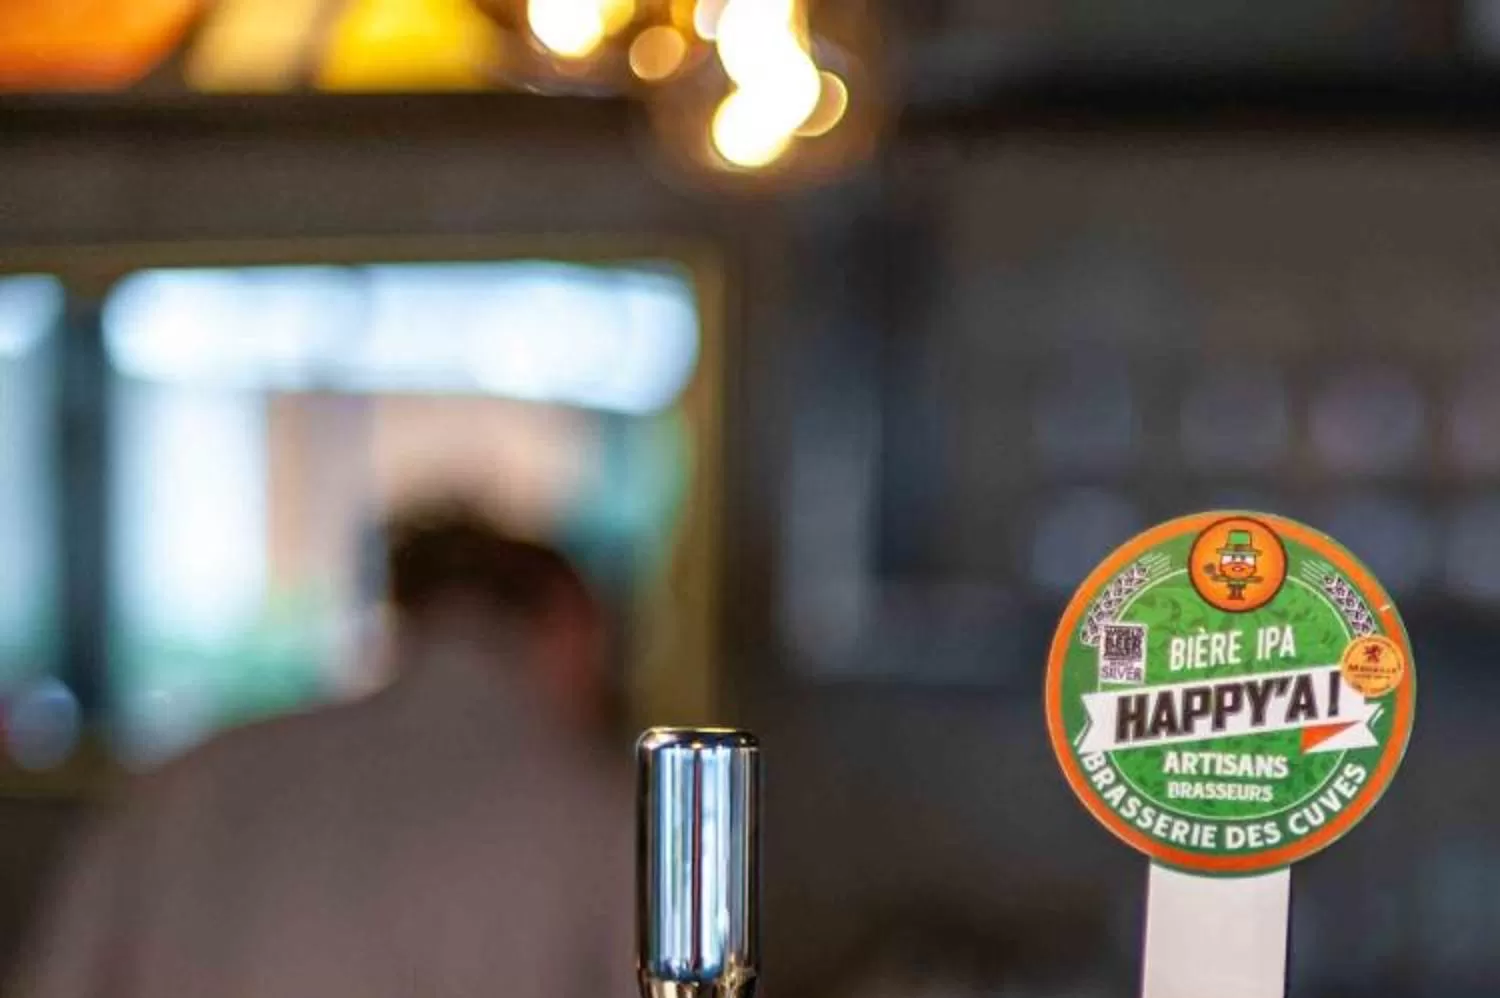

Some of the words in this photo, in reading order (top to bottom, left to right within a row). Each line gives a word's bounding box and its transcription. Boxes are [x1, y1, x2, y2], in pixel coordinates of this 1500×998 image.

[1169, 626, 1243, 671] BIÈRE
[1257, 625, 1296, 660] IPA
[1163, 751, 1289, 779] ARTISANS
[1081, 751, 1217, 849] BRASSERIE
[1225, 821, 1282, 850] DES
[1287, 761, 1367, 835] CUVES
[1167, 781, 1273, 802] BRASSEURS
